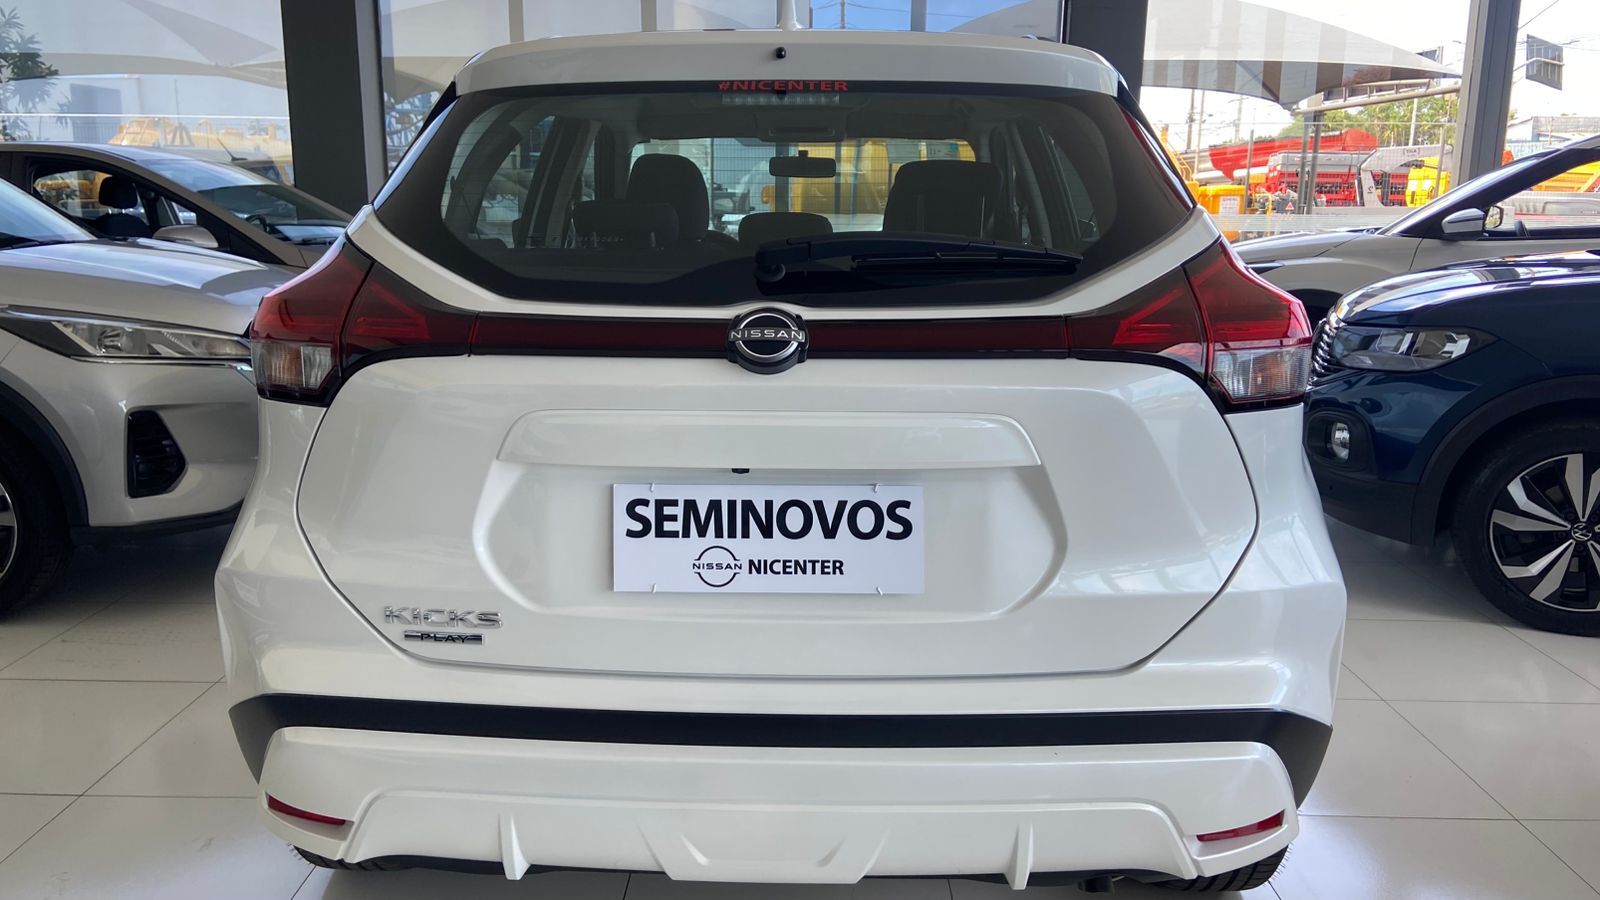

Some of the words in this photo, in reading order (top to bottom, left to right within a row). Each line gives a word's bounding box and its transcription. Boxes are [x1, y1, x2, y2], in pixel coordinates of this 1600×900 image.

[718, 79, 849, 92] #NICENTER
[730, 329, 804, 340] NISSAN
[625, 497, 914, 541] SEMINOVOS
[692, 561, 742, 571] NISSAN
[748, 559, 845, 576] NICENTER
[383, 605, 503, 629] KICKS
[420, 633, 470, 643] PLAY
